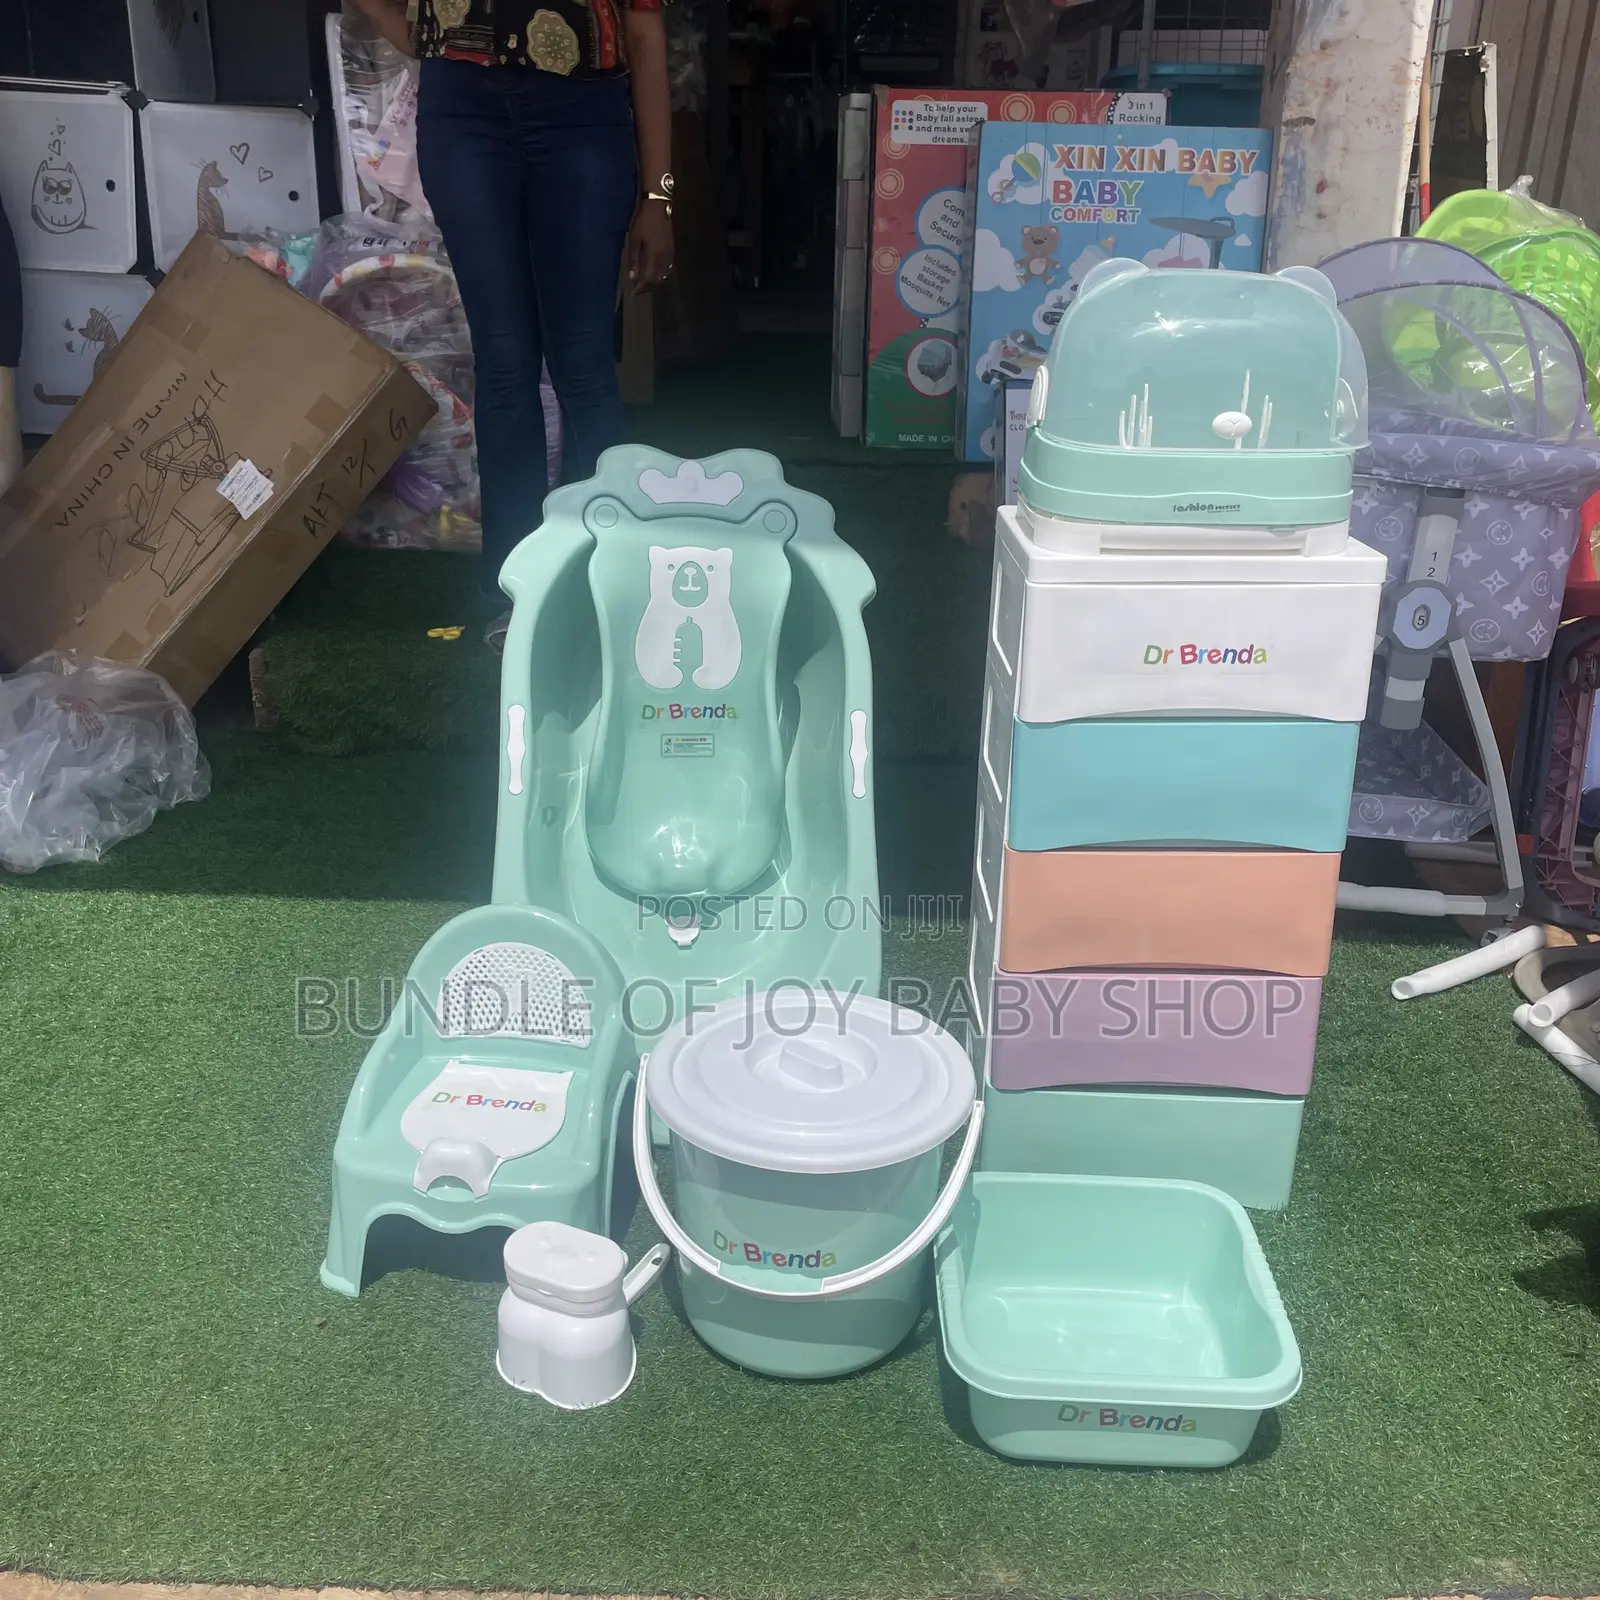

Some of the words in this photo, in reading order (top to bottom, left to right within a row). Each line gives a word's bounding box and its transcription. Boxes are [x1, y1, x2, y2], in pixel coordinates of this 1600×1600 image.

[936, 104, 956, 113] help
[1128, 101, 1133, 110] 3
[1136, 101, 1145, 110] in
[1149, 101, 1154, 110] 1
[916, 114, 938, 123] Baby
[941, 114, 954, 122] fall
[1120, 114, 1161, 125] Rocking
[1053, 144, 1107, 171] XIN
[1112, 145, 1168, 173] XIN
[1175, 147, 1260, 175] BABY
[1051, 178, 1144, 206] BABY
[943, 199, 965, 219] Com
[1050, 206, 1141, 224] COMFORT
[941, 214, 960, 228] and
[930, 220, 962, 246] Secure
[924, 254, 957, 276] Includes
[917, 273, 944, 293] Basket
[922, 265, 951, 285] storage
[936, 296, 951, 308] Net
[899, 434, 924, 442] MADE
[113, 436, 135, 460] IN
[55, 463, 113, 527] CHINA
[1173, 503, 1214, 512] fashion
[1432, 551, 1437, 562] 1
[1427, 567, 1436, 578] 2
[1417, 615, 1425, 626] 5
[1143, 644, 1174, 665] Dr
[1180, 644, 1267, 665] Brenda
[641, 704, 664, 720] Dr
[669, 703, 738, 720] Brenda
[432, 1092, 461, 1103] Dr
[466, 1094, 547, 1112] Brenda
[713, 1229, 738, 1254] Dr
[743, 1242, 837, 1268] Brenda
[1057, 1404, 1091, 1423] Dr
[1100, 1408, 1196, 1432] Brenda
